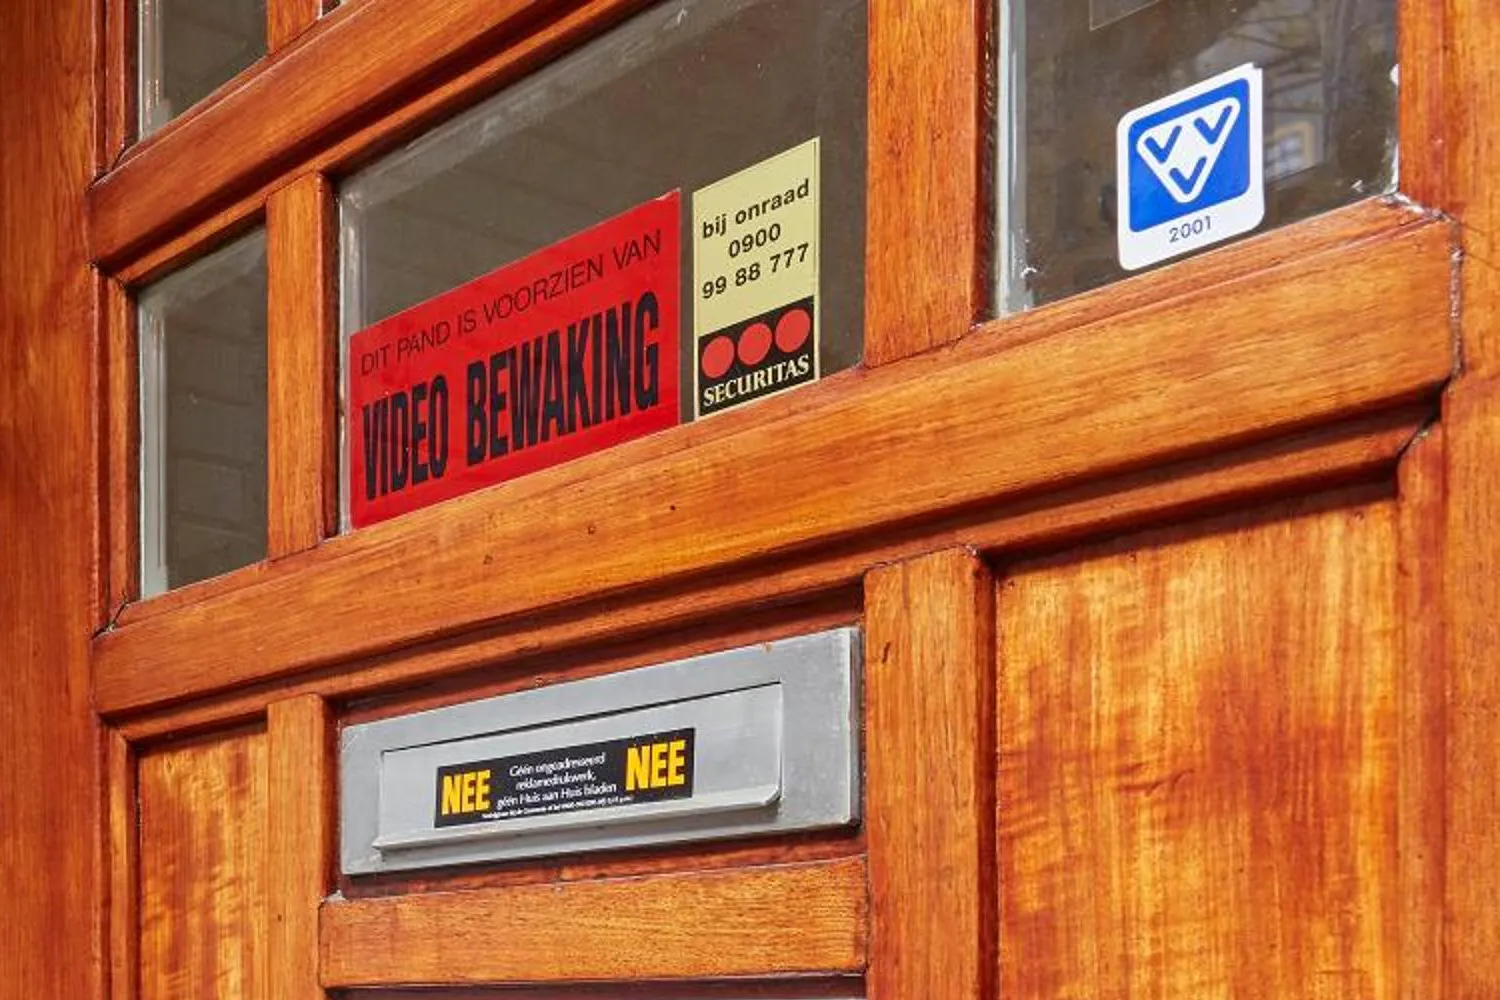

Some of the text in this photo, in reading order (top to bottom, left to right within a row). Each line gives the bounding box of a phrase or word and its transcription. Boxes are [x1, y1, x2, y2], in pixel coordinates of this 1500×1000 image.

[702, 179, 811, 239] bij onraad
[1168, 215, 1212, 244] 2001
[728, 223, 782, 258] 0900
[702, 244, 810, 299] 99 88 777
[361, 229, 662, 376] DIT PAND IS VOORZIEN VAN
[362, 290, 660, 500] VIDEO BEWAKING
[703, 353, 811, 407] SECURITAS
[626, 739, 686, 791] NEE
[441, 769, 491, 816] NEE
[519, 791, 540, 805] Huis
[541, 791, 558, 802] aan
[560, 786, 583, 799] Huis
[583, 782, 617, 796] bladen
